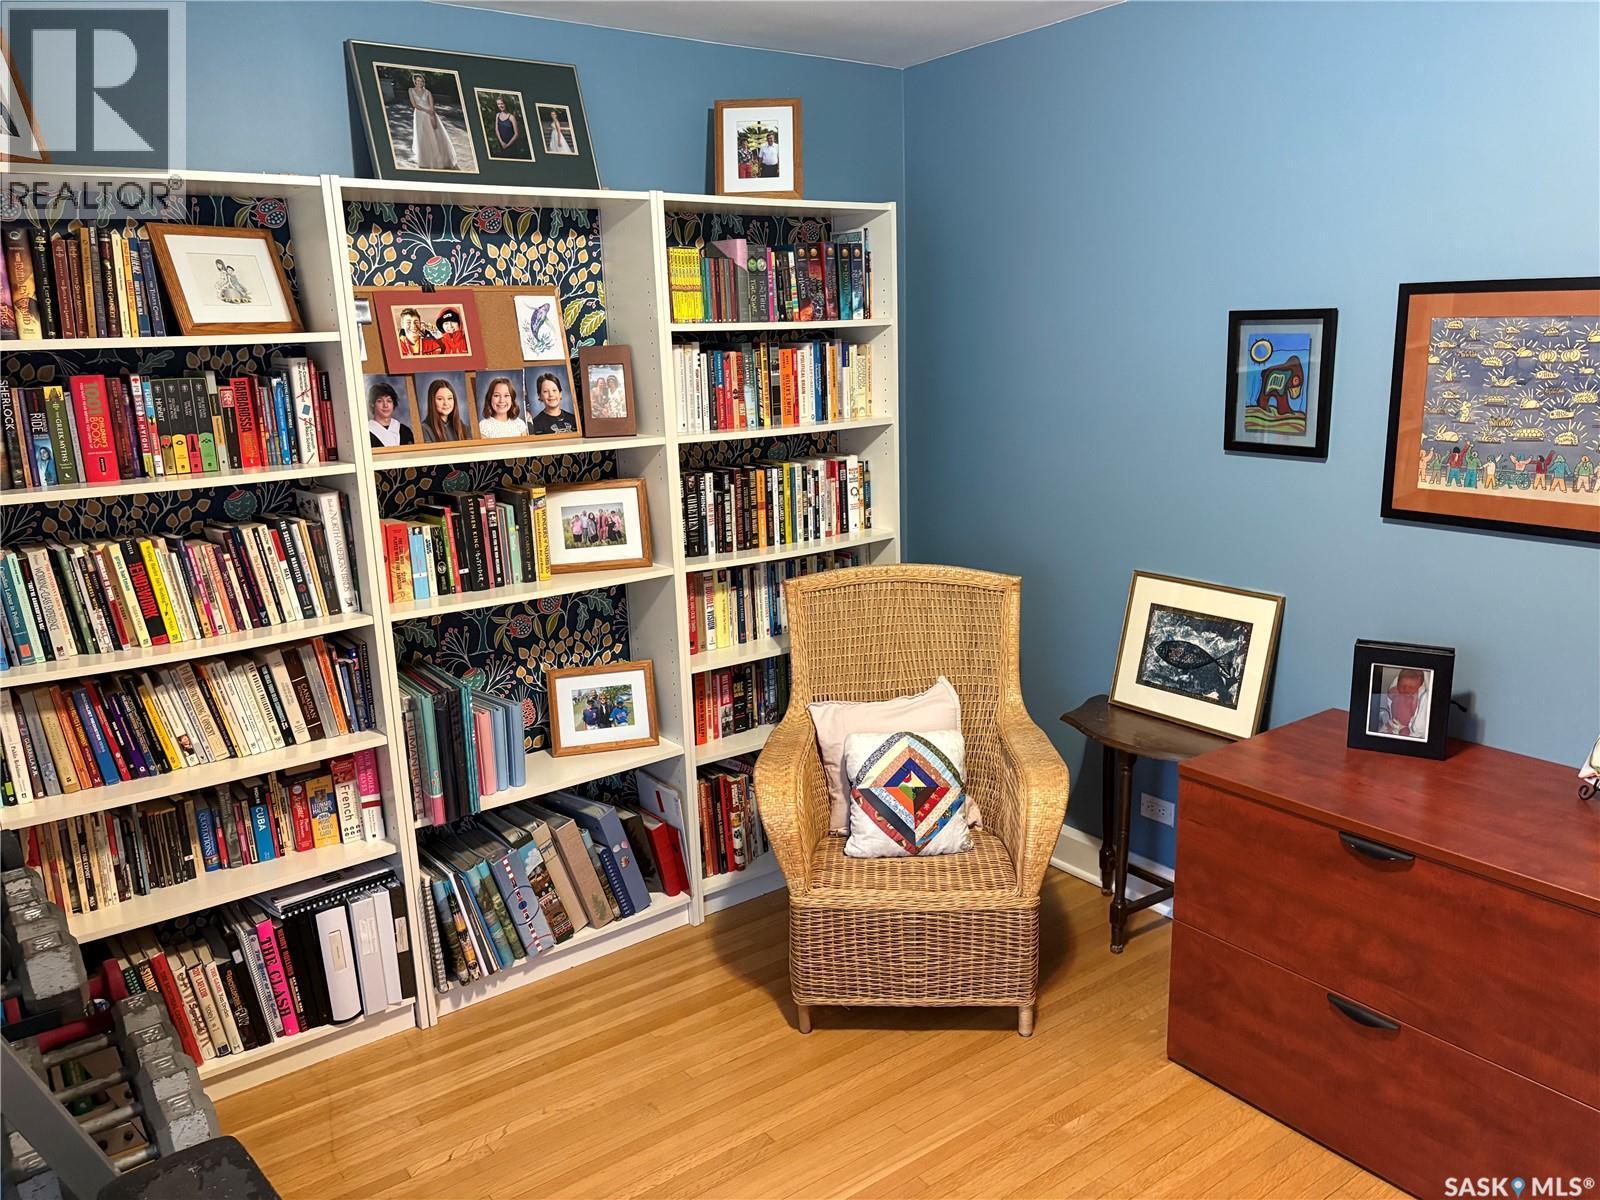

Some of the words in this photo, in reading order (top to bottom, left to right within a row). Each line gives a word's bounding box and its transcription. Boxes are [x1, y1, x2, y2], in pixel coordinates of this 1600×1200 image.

[0, 379, 15, 430] SHERLOCK
[234, 381, 252, 433] BARBAROSSA
[30, 413, 43, 433] RIDE
[55, 419, 64, 439] GREEK
[89, 417, 101, 448] BOOKS
[140, 424, 148, 451] INDIAN
[59, 440, 67, 462] MYTHS
[328, 512, 343, 539] NORTH
[467, 498, 478, 529] STEPHEN
[283, 531, 295, 555] SOCIALIST
[335, 539, 347, 572] AMERICAN
[706, 586, 714, 609] DOUBLE
[706, 611, 715, 630] VISION
[300, 683, 317, 719] CANADIAN
[407, 719, 417, 767] HUMAN
[412, 768, 422, 800] BODY
[341, 784, 354, 821] French
[256, 807, 266, 831] CUBA
[199, 813, 212, 856] QUOTATIONS
[195, 979, 207, 998] LAFLEUR
[260, 937, 277, 966] THE
[269, 970, 292, 1017] CLASH
